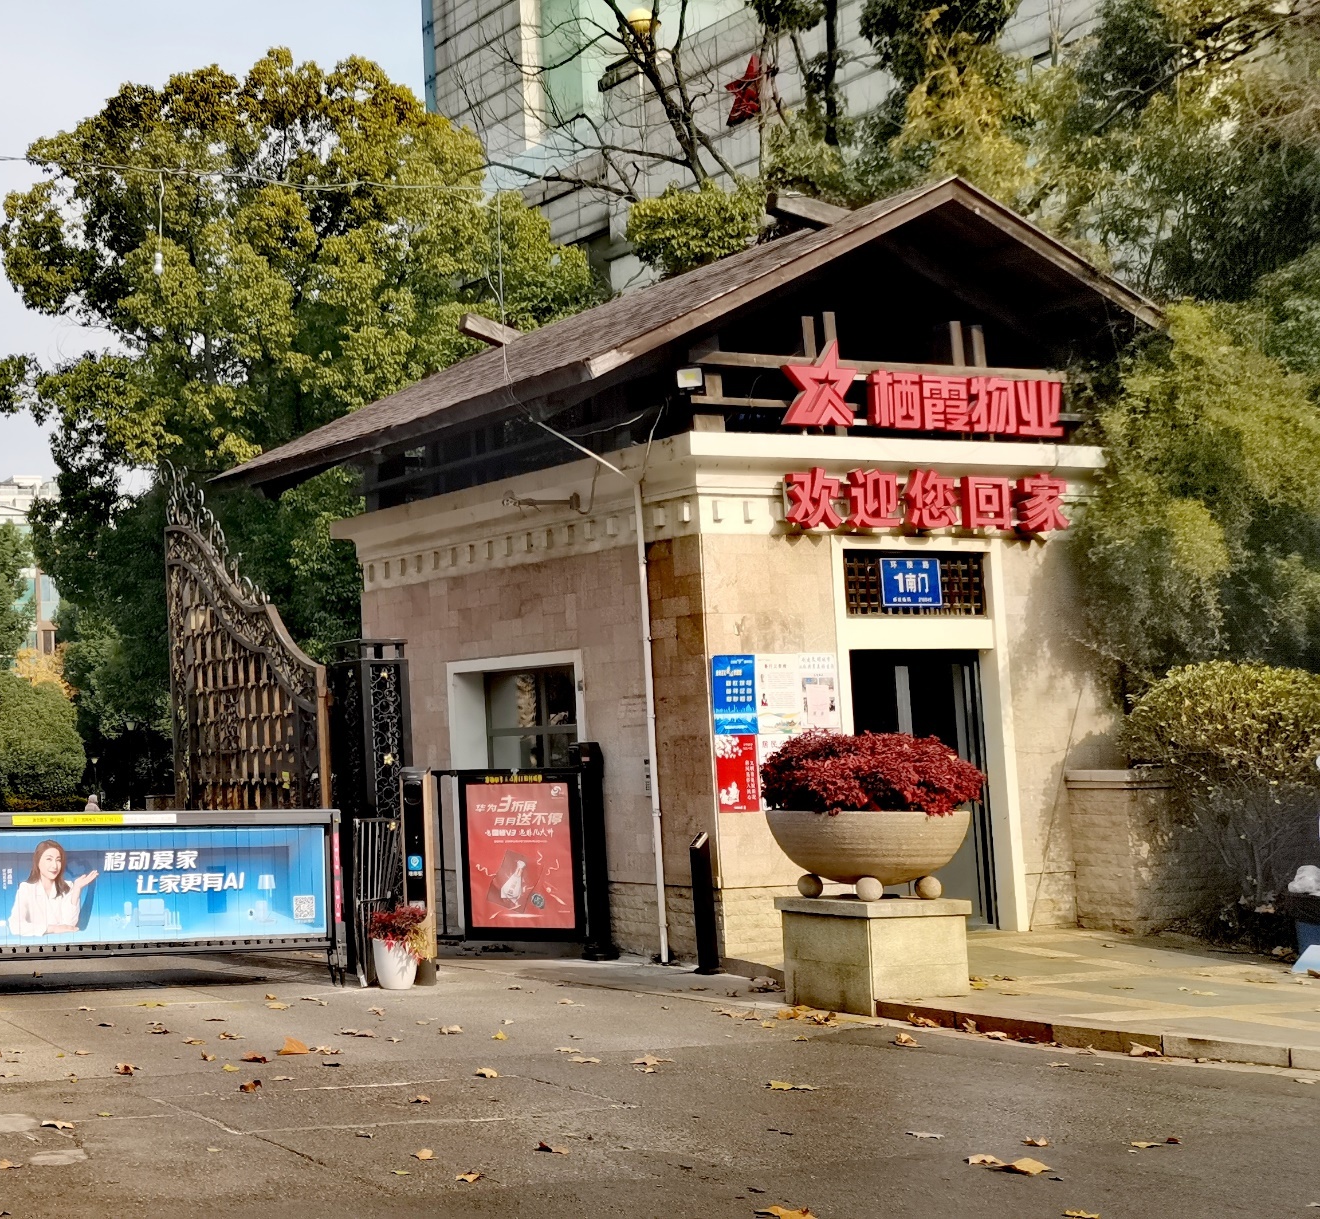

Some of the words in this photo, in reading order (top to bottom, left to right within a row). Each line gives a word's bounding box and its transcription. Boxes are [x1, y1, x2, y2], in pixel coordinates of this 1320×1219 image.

[867, 369, 1064, 438] 栖霞物业
[785, 466, 1070, 532] 欢迎您回家
[893, 572, 929, 593] 1南门
[494, 812, 564, 826] 月月送不停
[103, 850, 199, 872] 移动爱家
[136, 872, 245, 894] 让家更有AI
